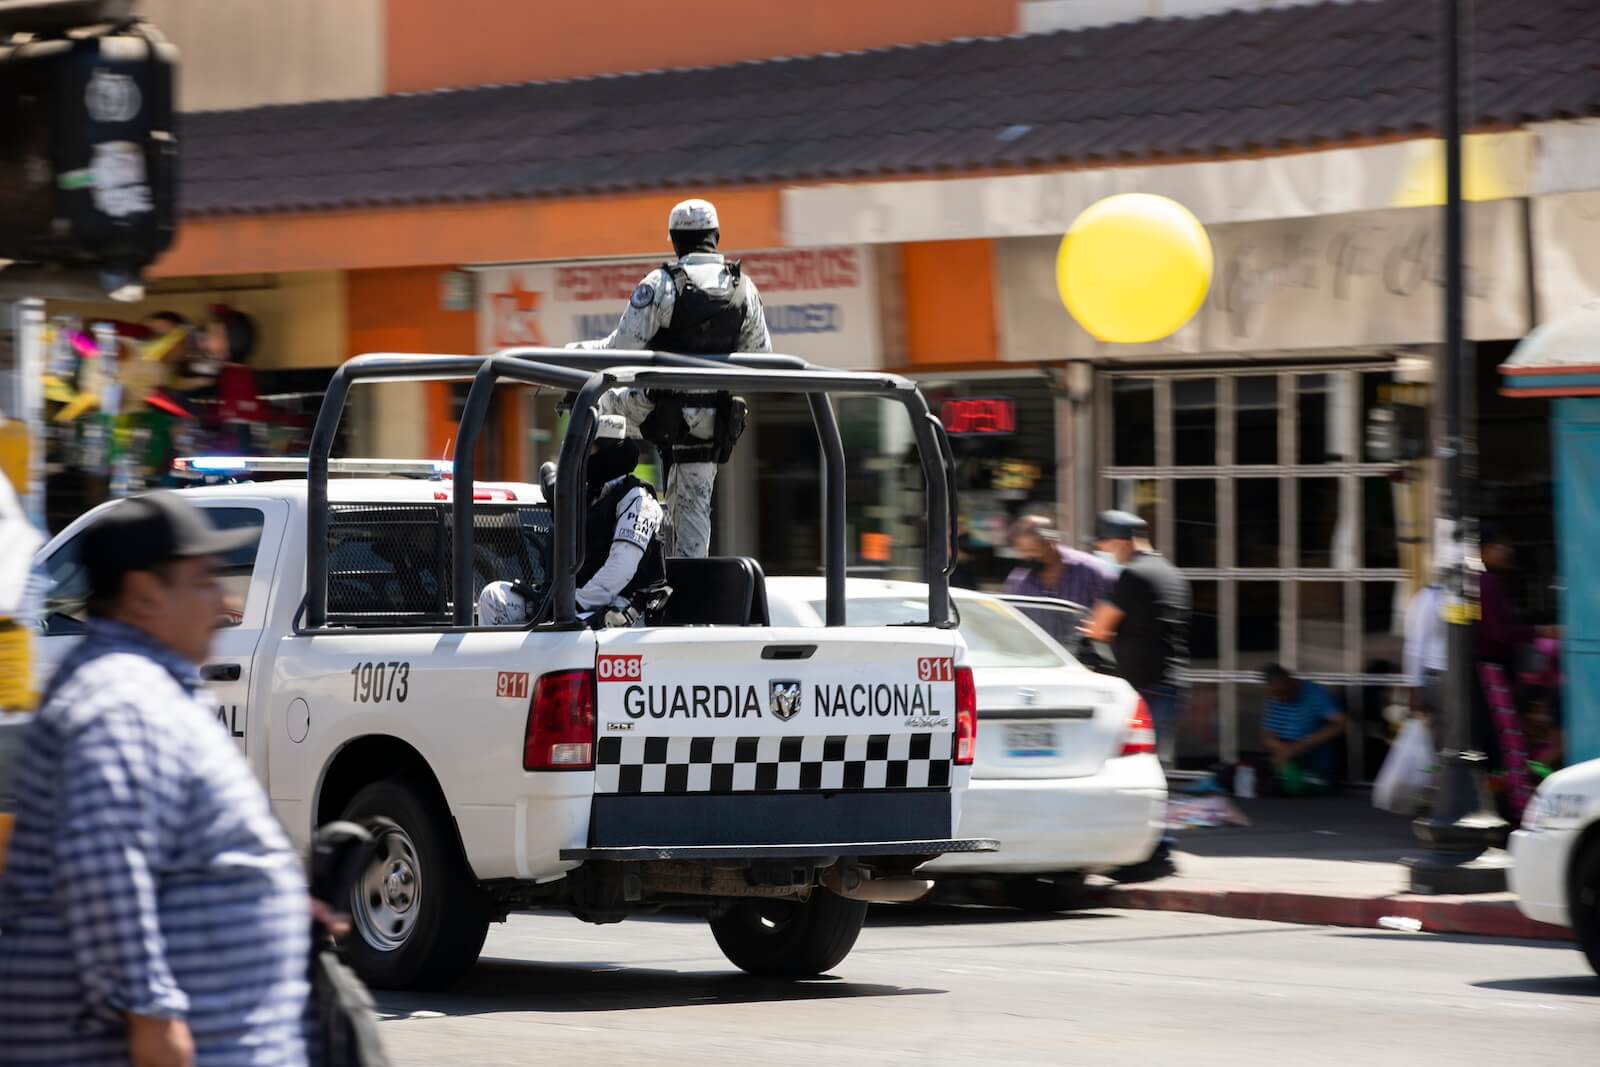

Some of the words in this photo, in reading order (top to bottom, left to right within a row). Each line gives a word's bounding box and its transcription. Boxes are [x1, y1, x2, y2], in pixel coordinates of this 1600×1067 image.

[599, 658, 640, 678] 088
[920, 658, 952, 681] 911
[350, 661, 409, 703] 19073
[498, 673, 527, 696] 911
[624, 684, 762, 719] GUARDIA
[814, 683, 940, 717] NACIONAL
